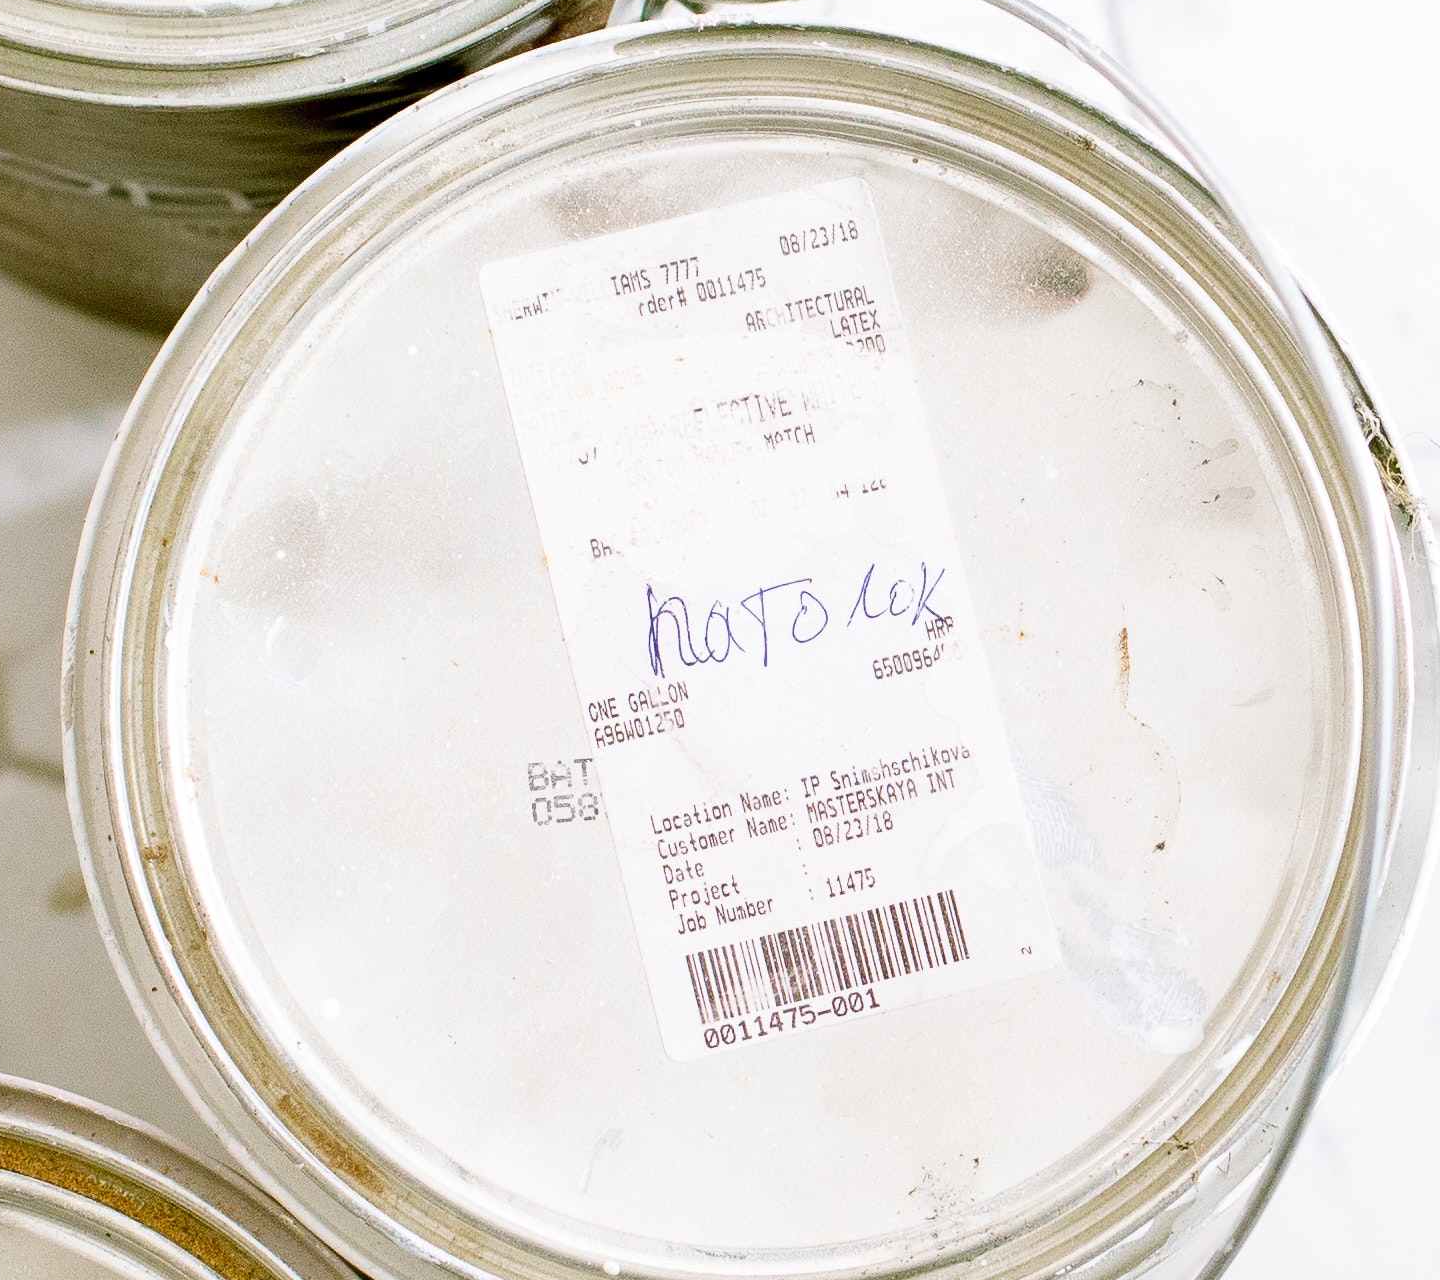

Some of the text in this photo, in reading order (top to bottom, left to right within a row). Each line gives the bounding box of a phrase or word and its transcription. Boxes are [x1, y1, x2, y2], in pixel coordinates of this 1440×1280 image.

[658, 255, 699, 285] 7777
[778, 218, 859, 256] 08/23/18
[637, 266, 767, 317] rder# 0011475
[744, 284, 875, 332] ARCHITECTURAL
[828, 308, 881, 339] LATEX
[762, 422, 816, 450] MATCH
[649, 745, 971, 835] Location Name: IP Snimshschikova
[656, 766, 955, 860] Customer Name: MASTERSKAYA INT
[661, 809, 894, 885] Date 08/23/18
[667, 873, 740, 910] Project
[677, 866, 876, 935] Job Number 11475
[702, 986, 881, 1049] 0011475-001
